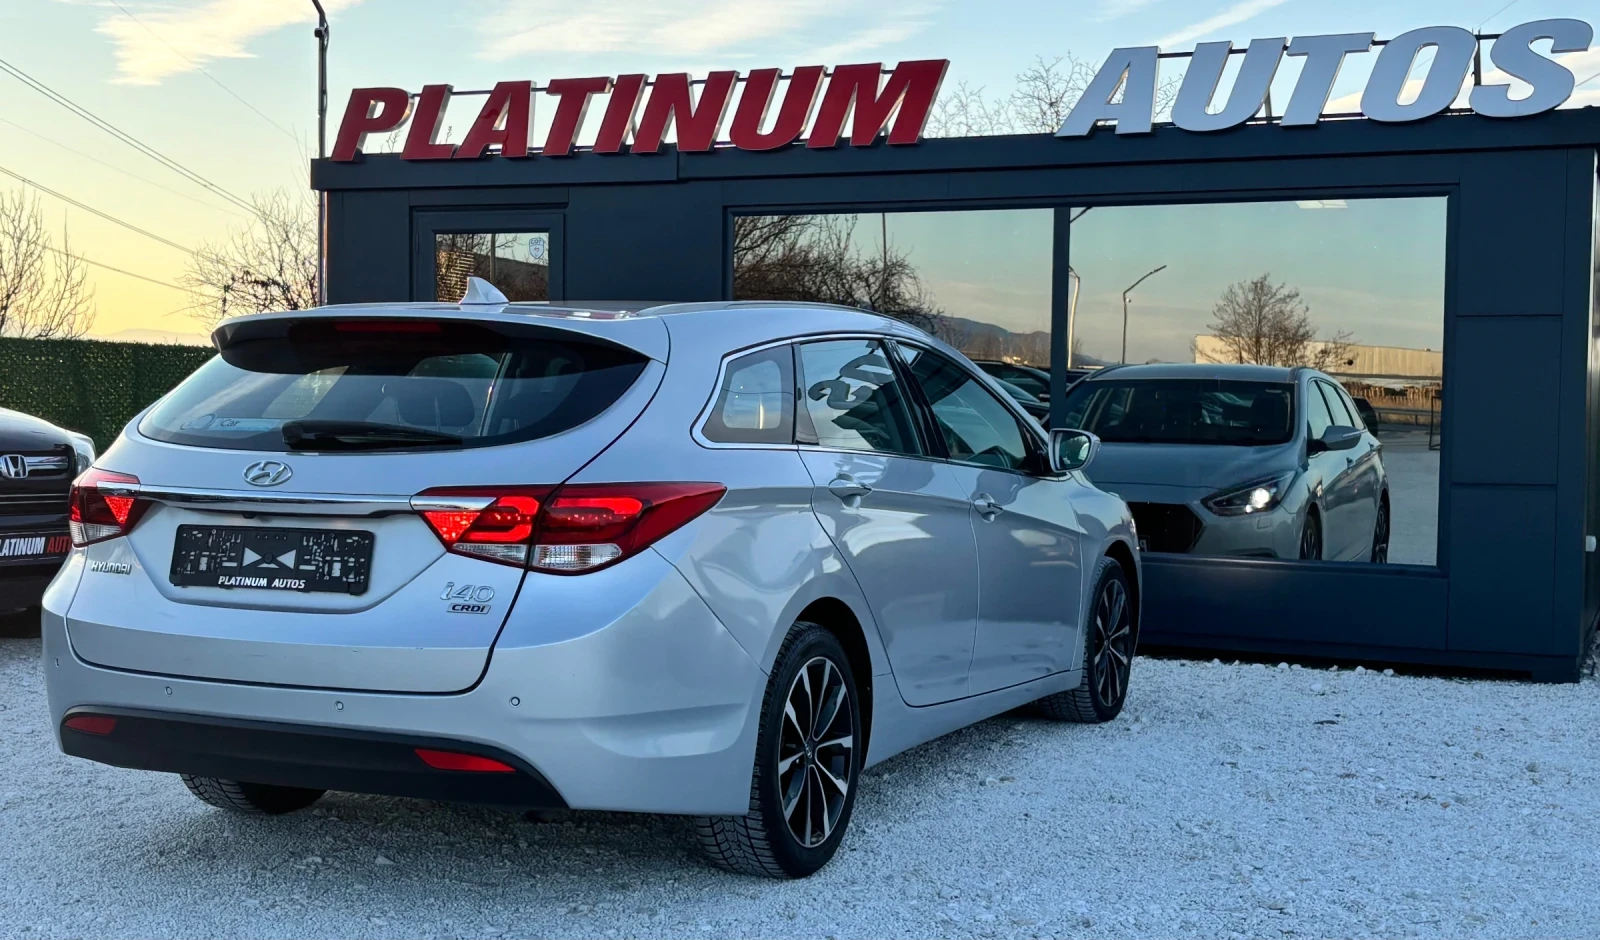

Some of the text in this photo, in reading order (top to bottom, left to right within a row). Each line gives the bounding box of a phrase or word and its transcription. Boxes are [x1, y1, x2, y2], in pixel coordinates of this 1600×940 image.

[331, 18, 1594, 162] PLATINUM AUTOS
[91, 561, 132, 575] HYUNDAI
[218, 576, 306, 589] PLATINUM AUTOS
[440, 581, 495, 602] i40
